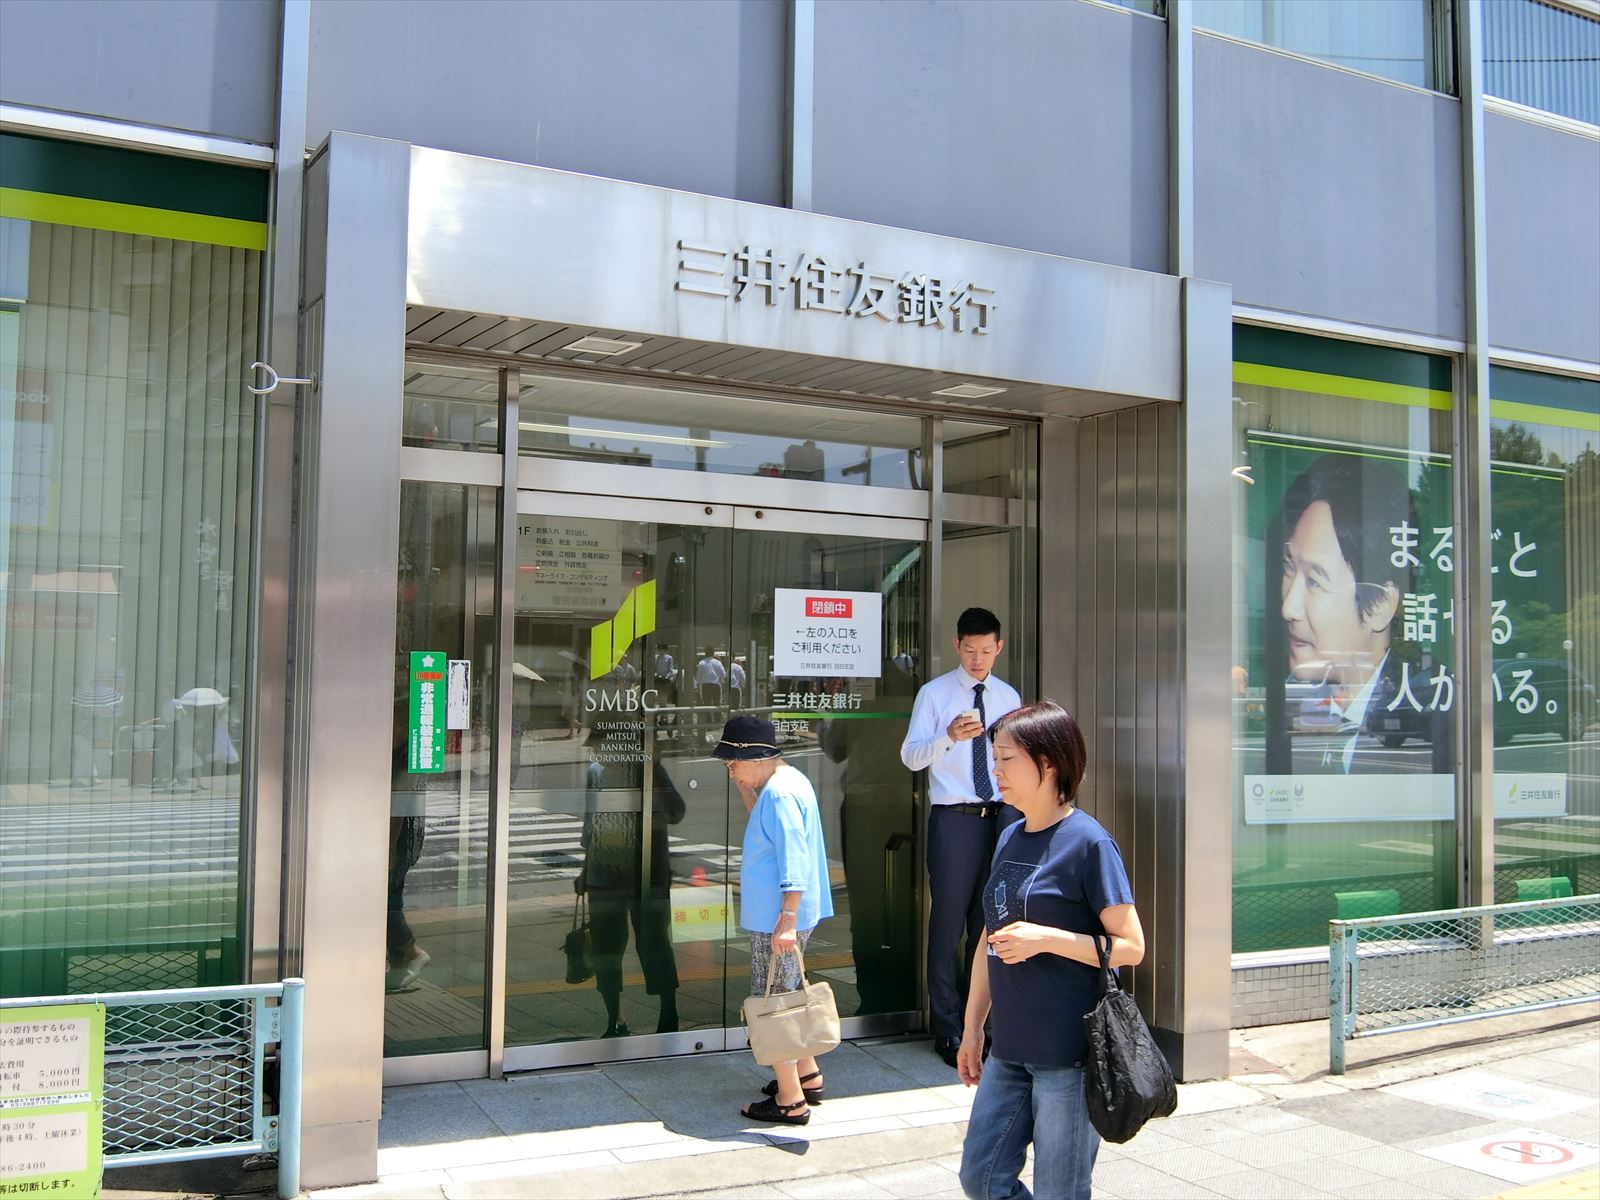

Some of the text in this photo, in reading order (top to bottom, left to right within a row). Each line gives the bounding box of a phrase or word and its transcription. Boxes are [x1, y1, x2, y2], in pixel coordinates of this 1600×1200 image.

[674, 239, 997, 335] 三井住友銀行
[518, 526, 531, 536] 1F
[812, 601, 846, 614] 閉鎖中
[806, 627, 858, 639] 左の入口を
[792, 642, 862, 654] ご利用ください
[585, 688, 658, 712] SMBC
[772, 692, 862, 709] 三井住友銀行
[597, 721, 646, 730] SUMITOMO
[606, 732, 636, 740] MITSUI
[601, 743, 641, 751] BANKING
[589, 754, 652, 762] CORPORATION
[1520, 790, 1561, 799] 三井住友銀行
[0, 1072, 20, 1080] 転車
